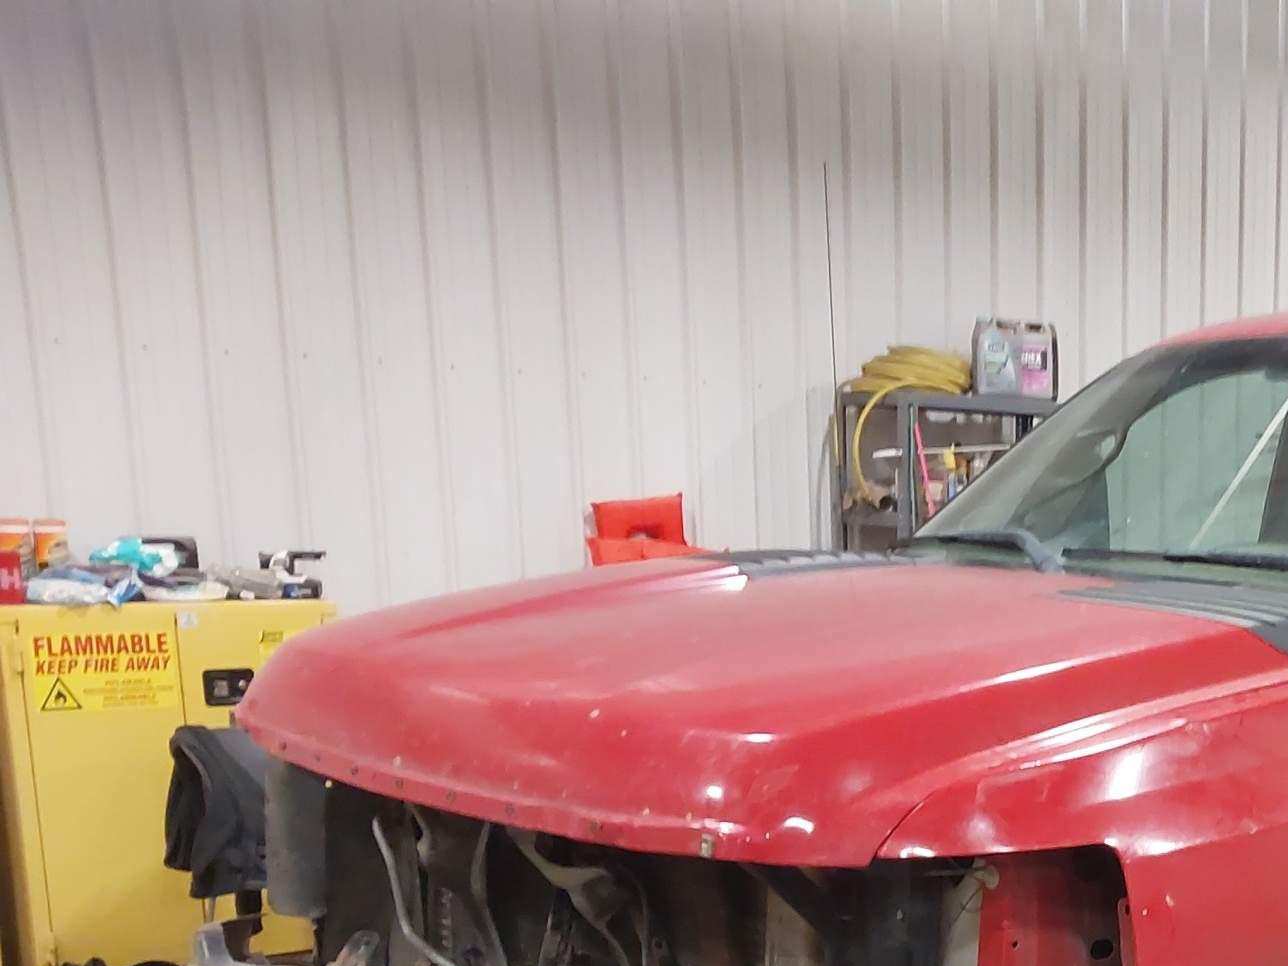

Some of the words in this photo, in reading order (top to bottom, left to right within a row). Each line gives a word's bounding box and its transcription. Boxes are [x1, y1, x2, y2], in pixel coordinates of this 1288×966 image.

[33, 632, 169, 658] FLAMMABLE
[35, 658, 78, 676] KEEP
[83, 656, 119, 674] FIRE
[125, 655, 171, 672] AWAY
